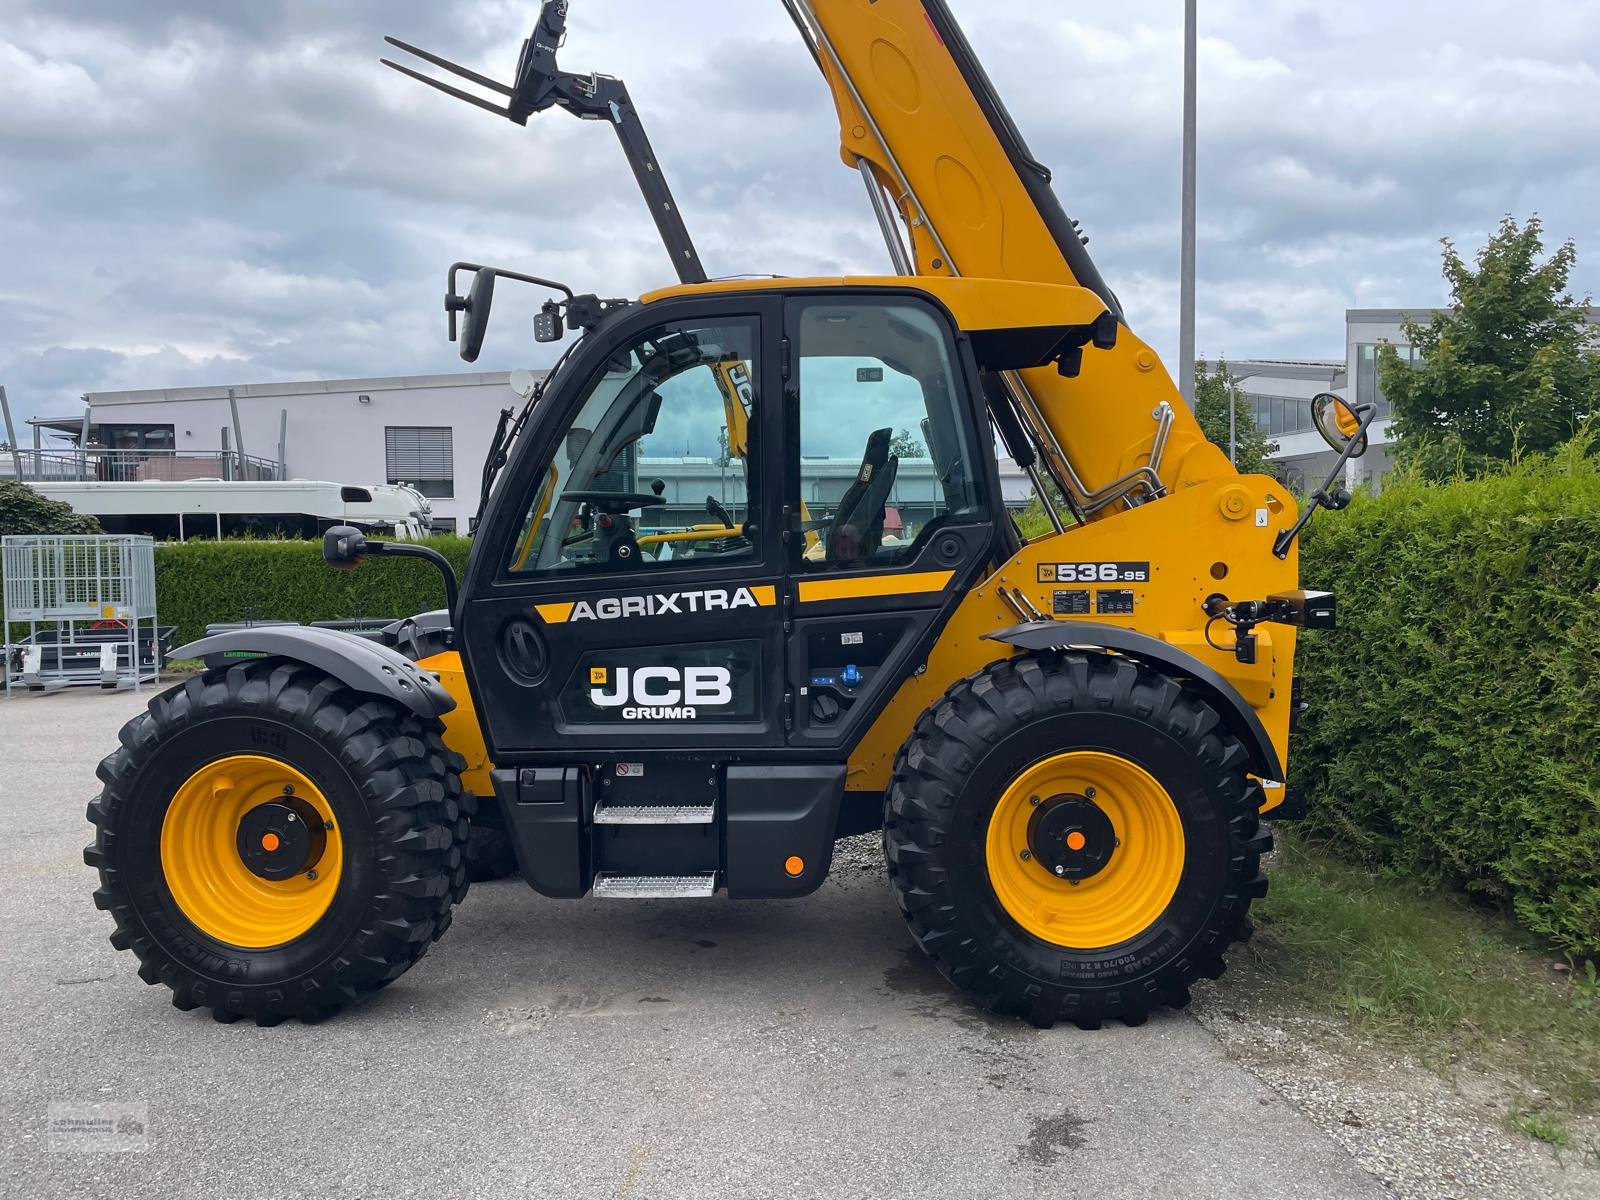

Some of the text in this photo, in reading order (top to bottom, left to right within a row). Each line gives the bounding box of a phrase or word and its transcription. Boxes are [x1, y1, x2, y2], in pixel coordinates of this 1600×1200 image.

[1057, 564, 1145, 581] 536-95
[570, 586, 759, 622] AGRIXTRA
[590, 666, 732, 706] JCB
[622, 707, 696, 719] GRUMA
